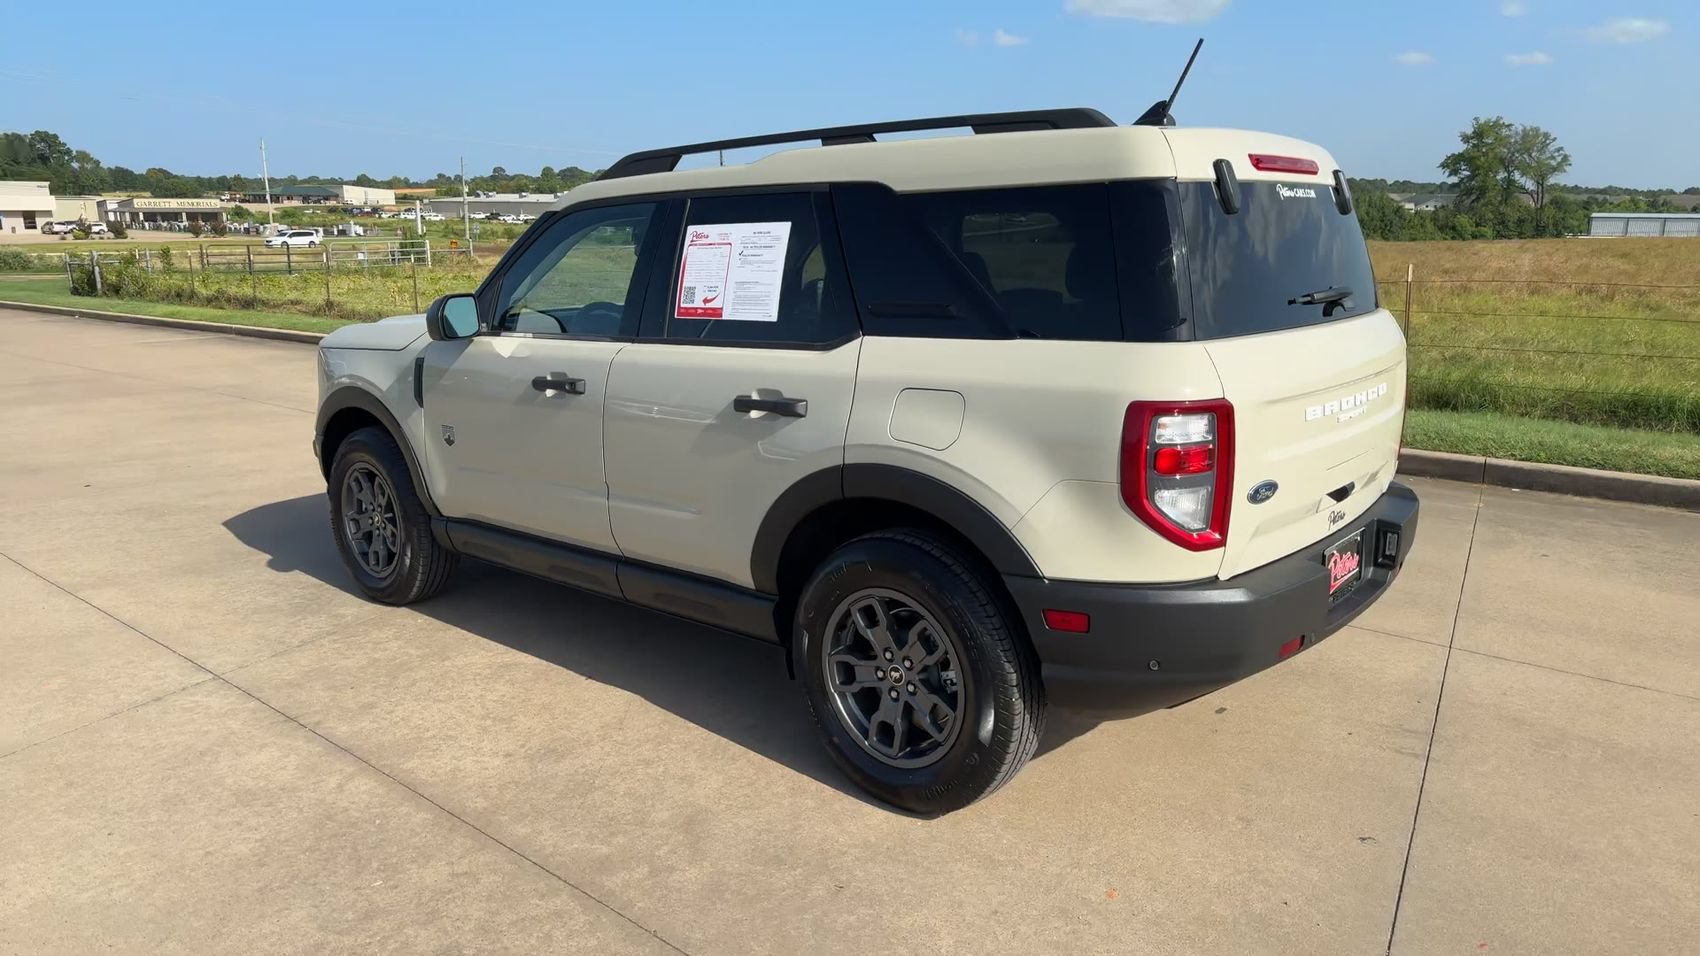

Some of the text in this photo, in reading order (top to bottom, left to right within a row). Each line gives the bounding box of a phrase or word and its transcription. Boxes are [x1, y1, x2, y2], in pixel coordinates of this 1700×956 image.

[690, 230, 709, 241] Peters
[1305, 382, 1387, 422] BRONCO
[1327, 510, 1346, 531] Peters
[1328, 551, 1360, 590] Peters
